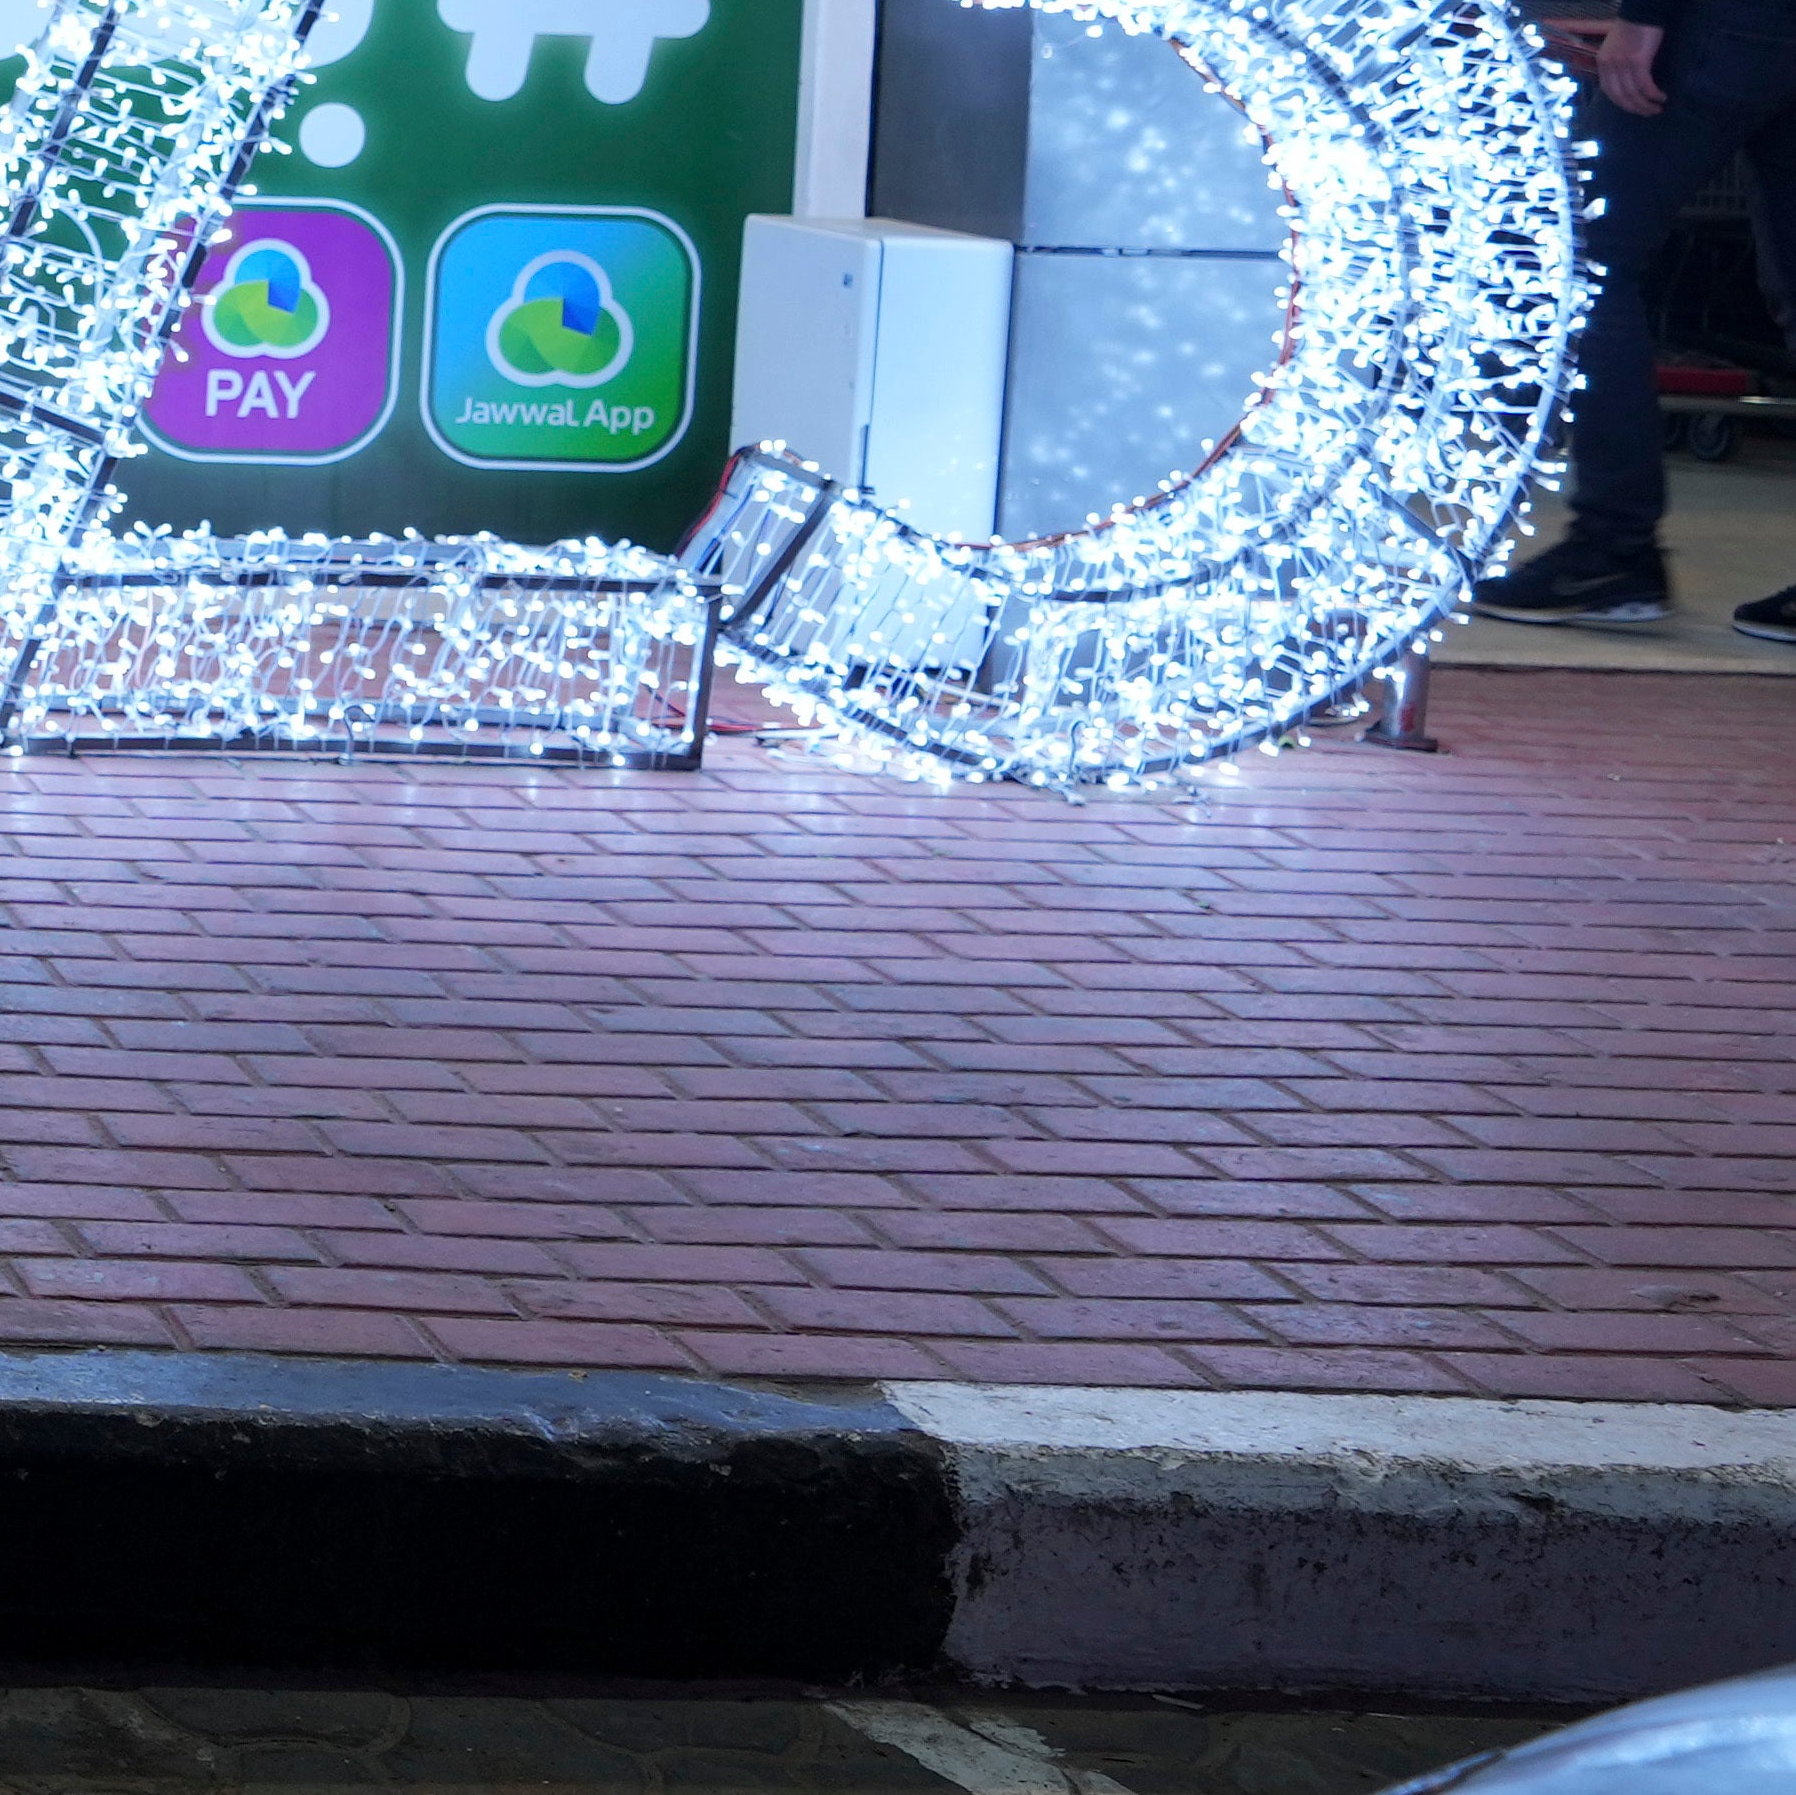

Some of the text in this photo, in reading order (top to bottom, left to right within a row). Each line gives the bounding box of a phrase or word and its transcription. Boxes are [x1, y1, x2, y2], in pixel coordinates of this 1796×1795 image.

[205, 368, 316, 420] PAY
[454, 396, 656, 435] Jawwal App
